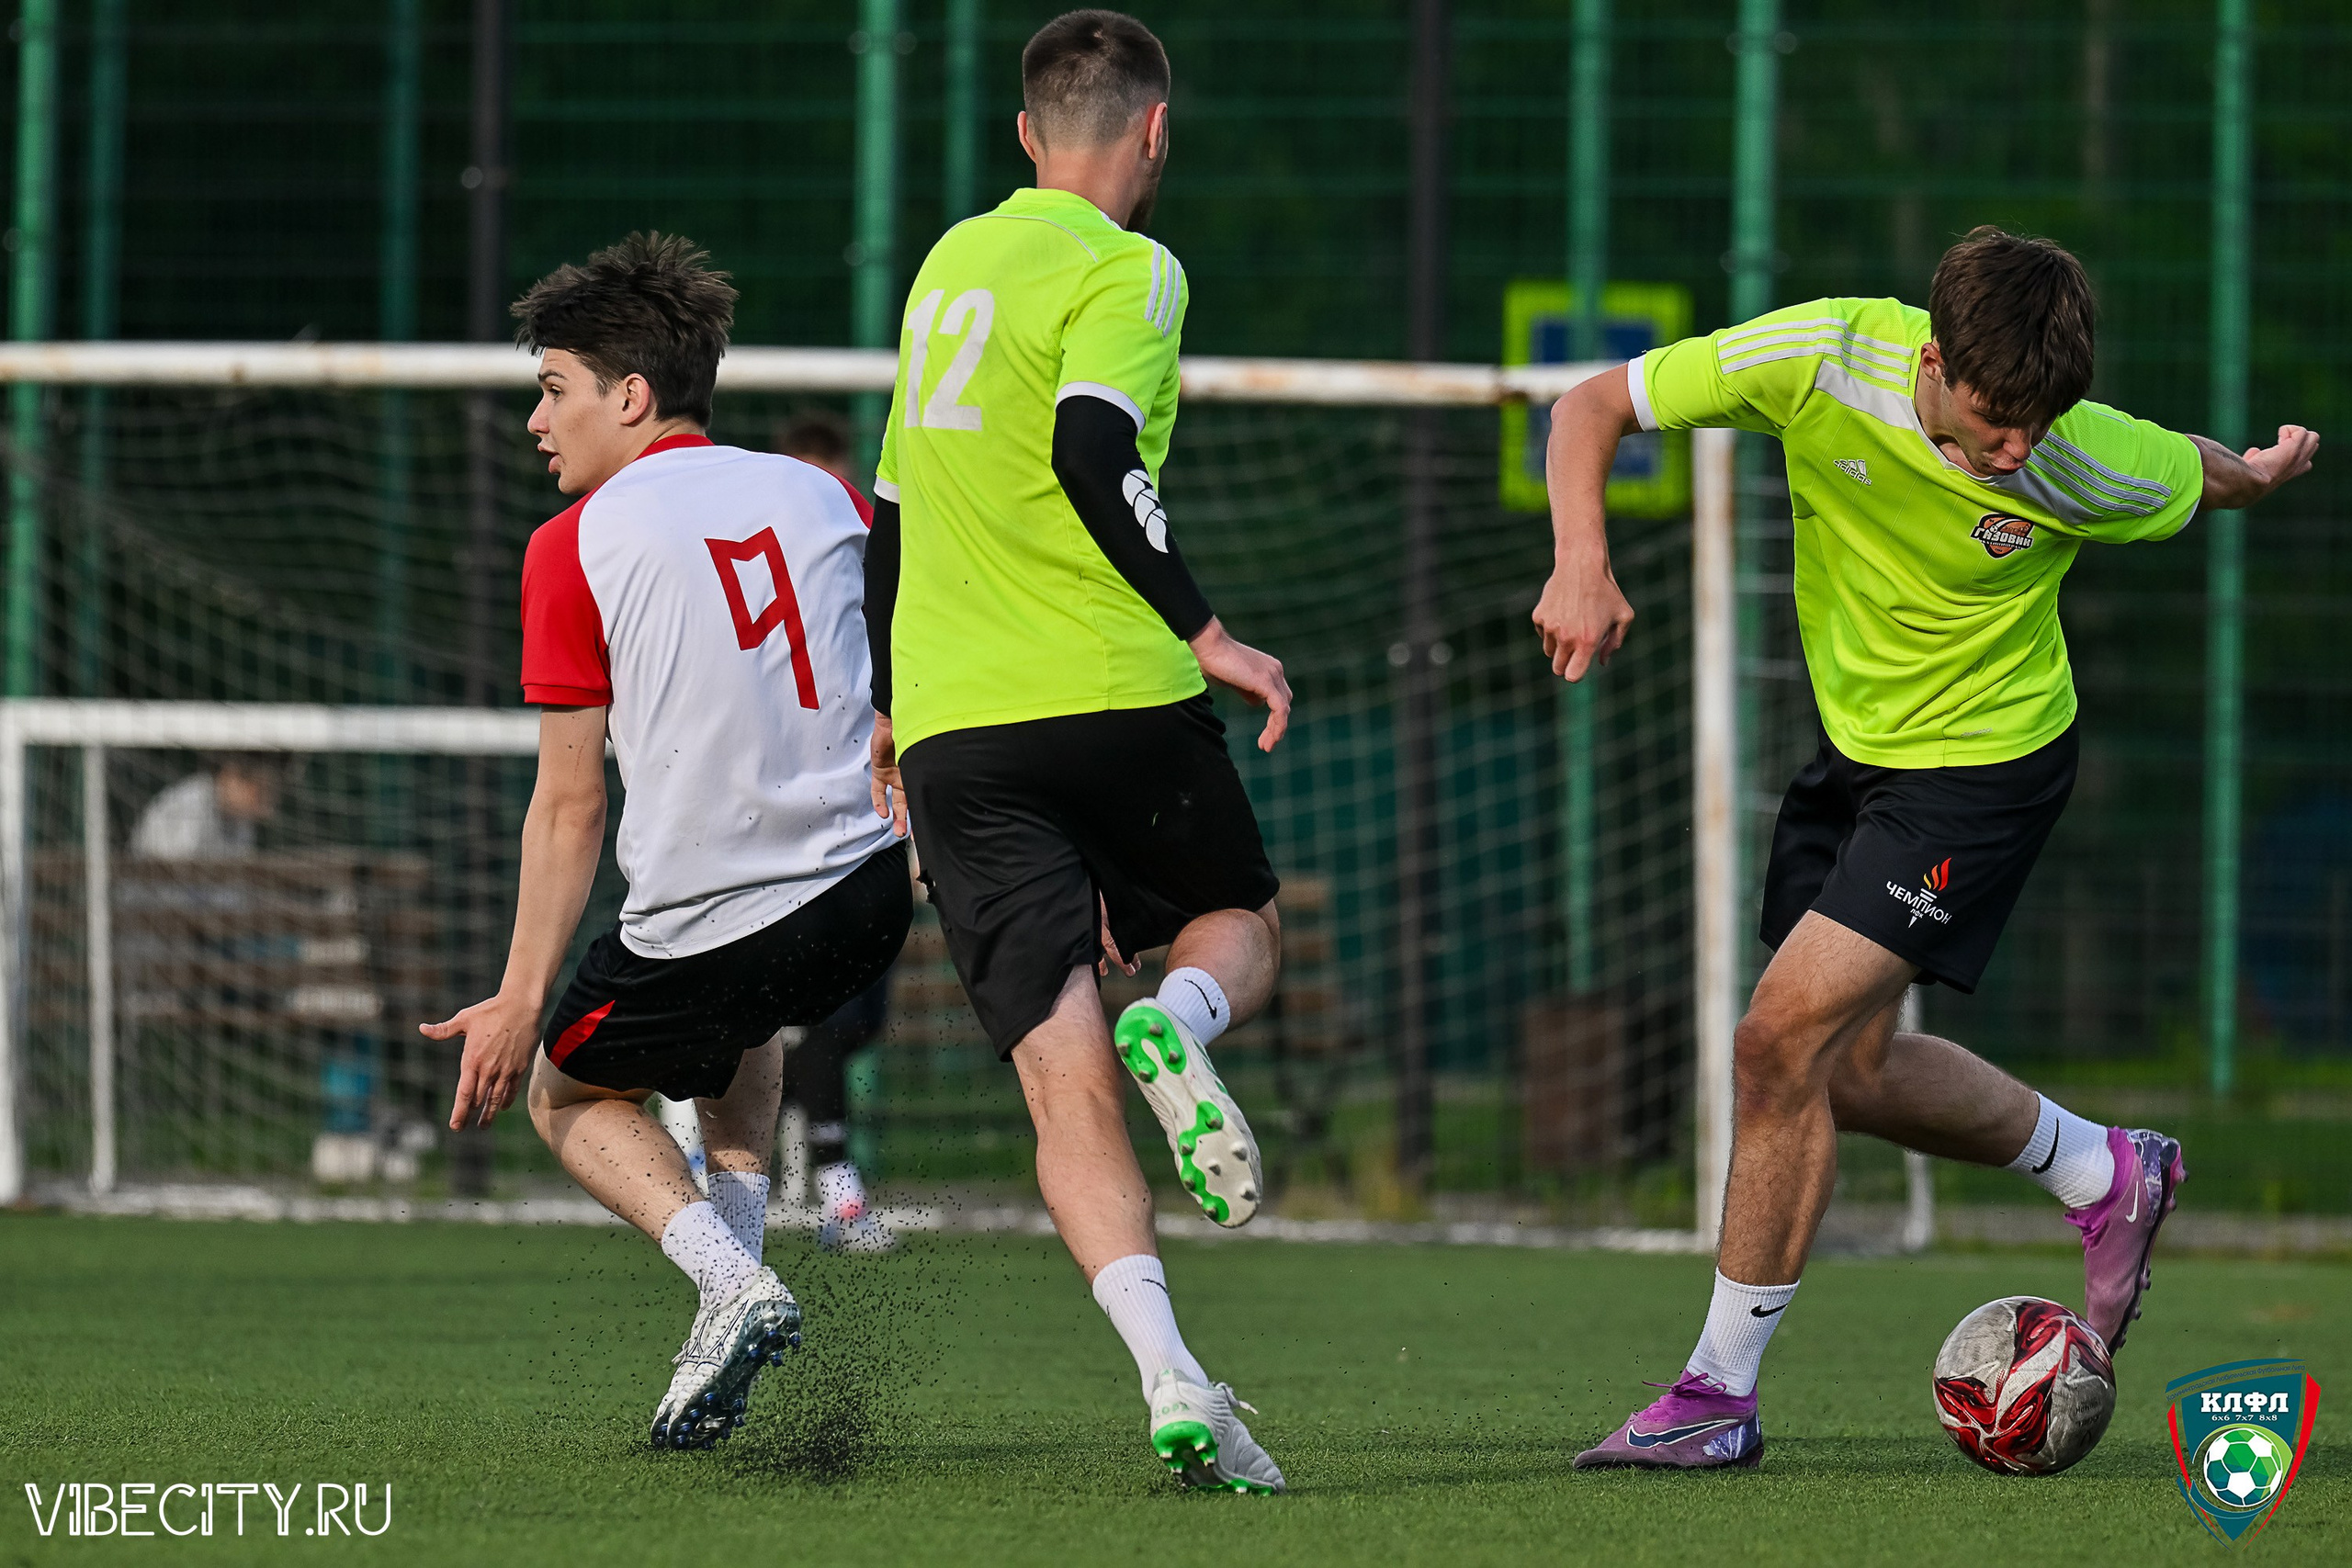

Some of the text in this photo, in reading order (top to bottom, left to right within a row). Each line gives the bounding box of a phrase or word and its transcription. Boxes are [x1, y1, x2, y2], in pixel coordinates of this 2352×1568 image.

[904, 288, 995, 432] 12
[1833, 459, 1872, 486] adidas
[1973, 527, 2031, 547] ГАЗОВИК
[704, 525, 820, 711] 9
[1886, 880, 1952, 925] ЧЕМПИОН
